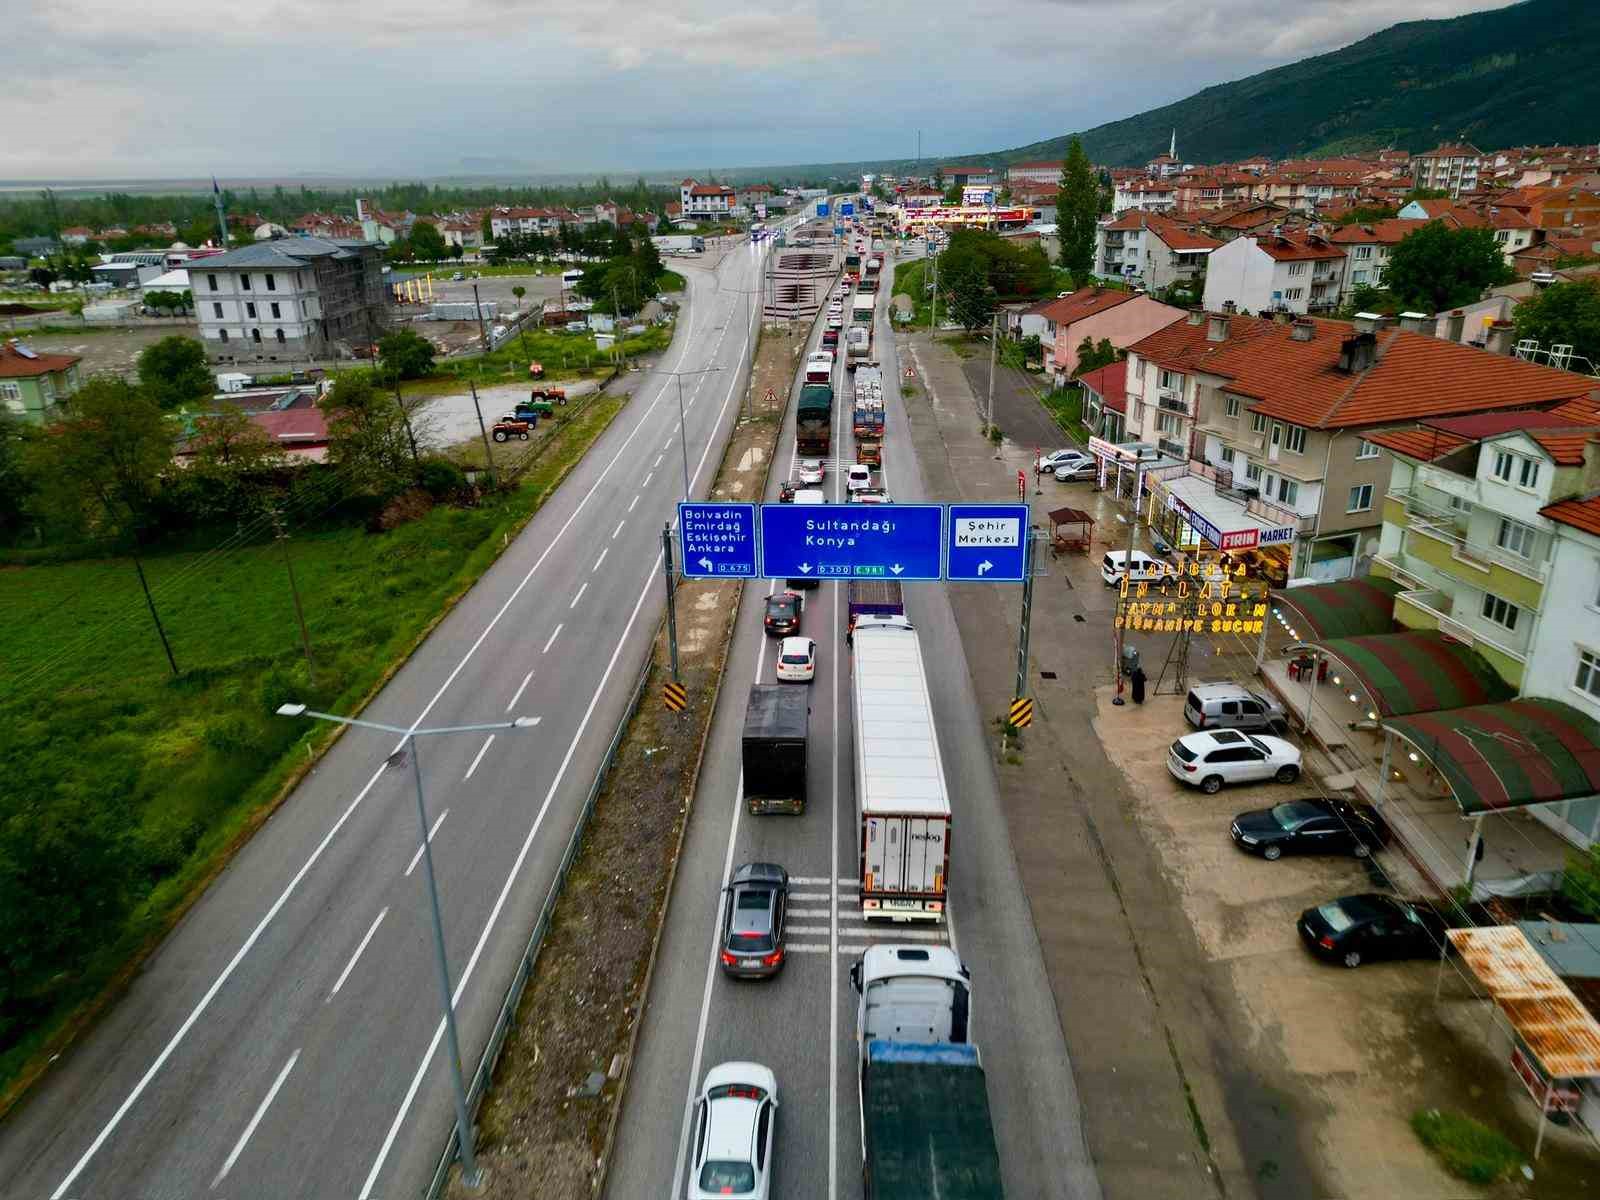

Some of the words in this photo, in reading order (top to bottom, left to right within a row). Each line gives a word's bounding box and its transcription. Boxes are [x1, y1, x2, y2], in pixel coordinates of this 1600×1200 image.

[685, 510, 742, 519] Bolvadin
[686, 521, 740, 533] Emirdağ
[806, 519, 896, 533] Sultandağı
[968, 521, 1006, 531] Şehir
[687, 532, 747, 543] Eskişehir
[958, 535, 1015, 543] Merkezi
[1223, 533, 1255, 548] FIRIN
[1260, 527, 1294, 543] MARKET
[806, 535, 855, 548] Konya
[688, 544, 734, 552] Ankara
[1211, 619, 1265, 633] SUCUK
